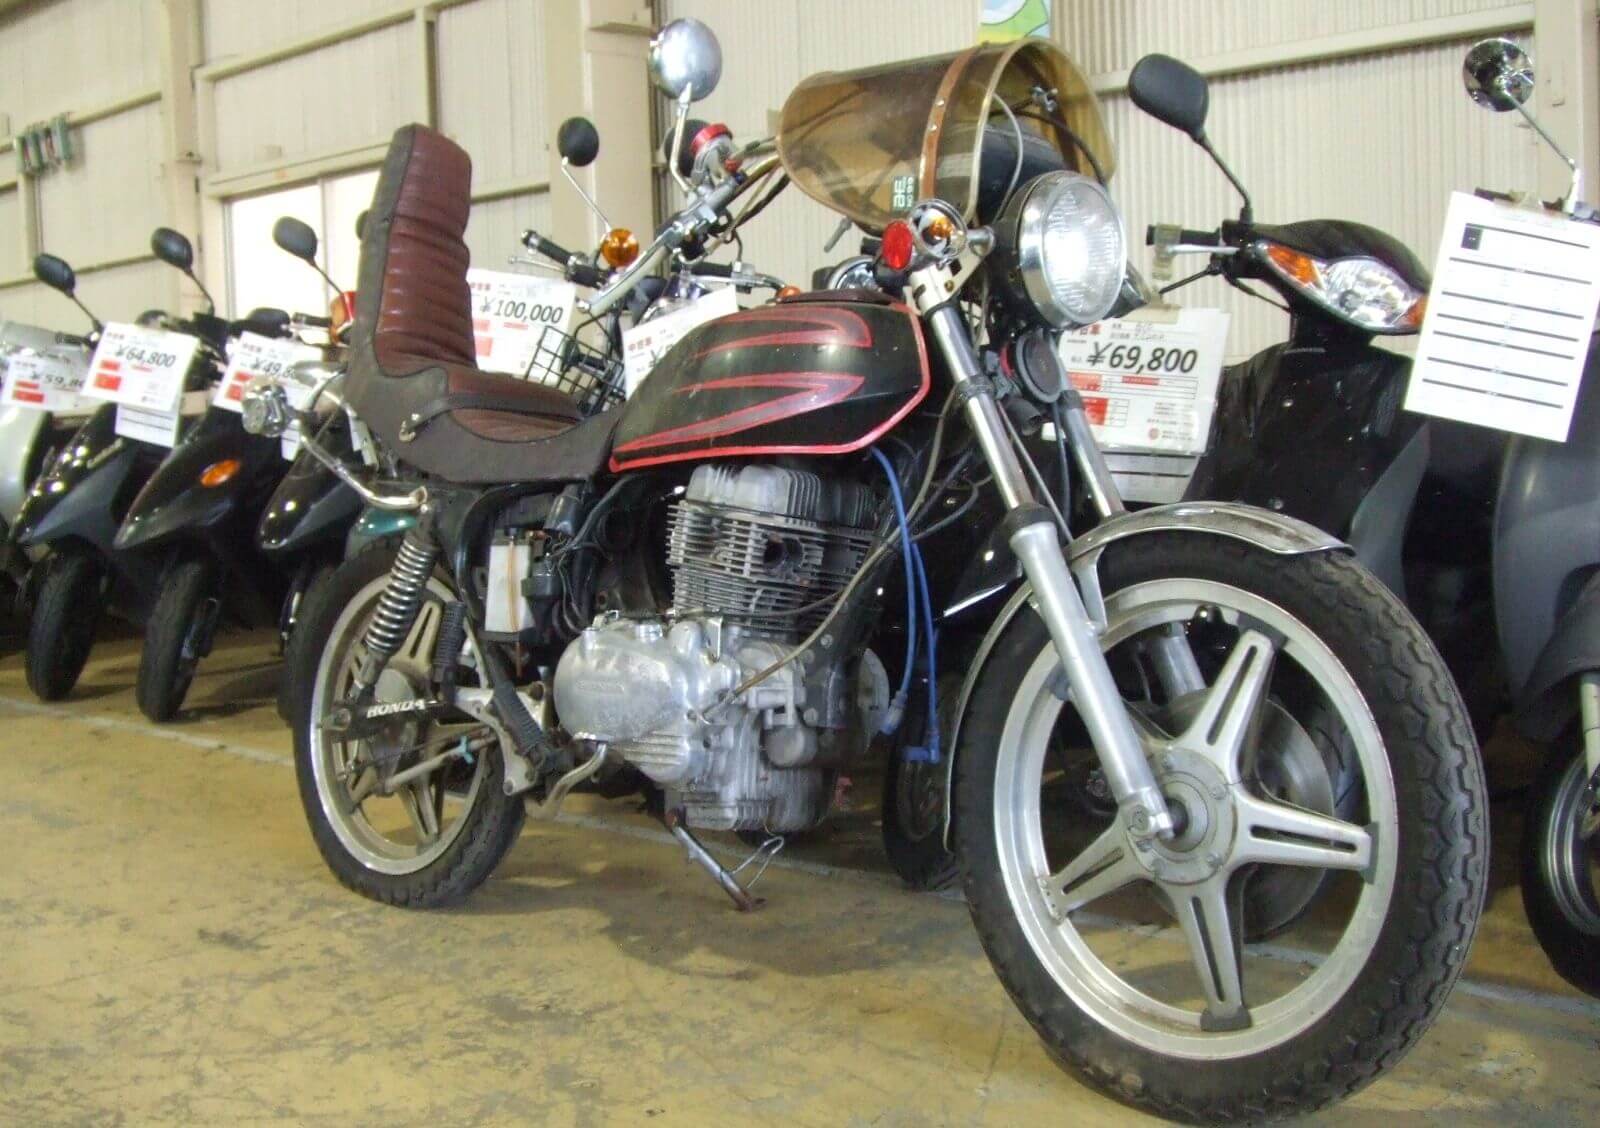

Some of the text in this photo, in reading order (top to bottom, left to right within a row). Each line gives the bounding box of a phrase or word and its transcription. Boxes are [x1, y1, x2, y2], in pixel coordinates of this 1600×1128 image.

[480, 295, 564, 324] ¥100,000
[115, 344, 178, 368] ¥64,800
[1087, 341, 1198, 374] ¥69,800
[366, 698, 427, 719] HONDA
